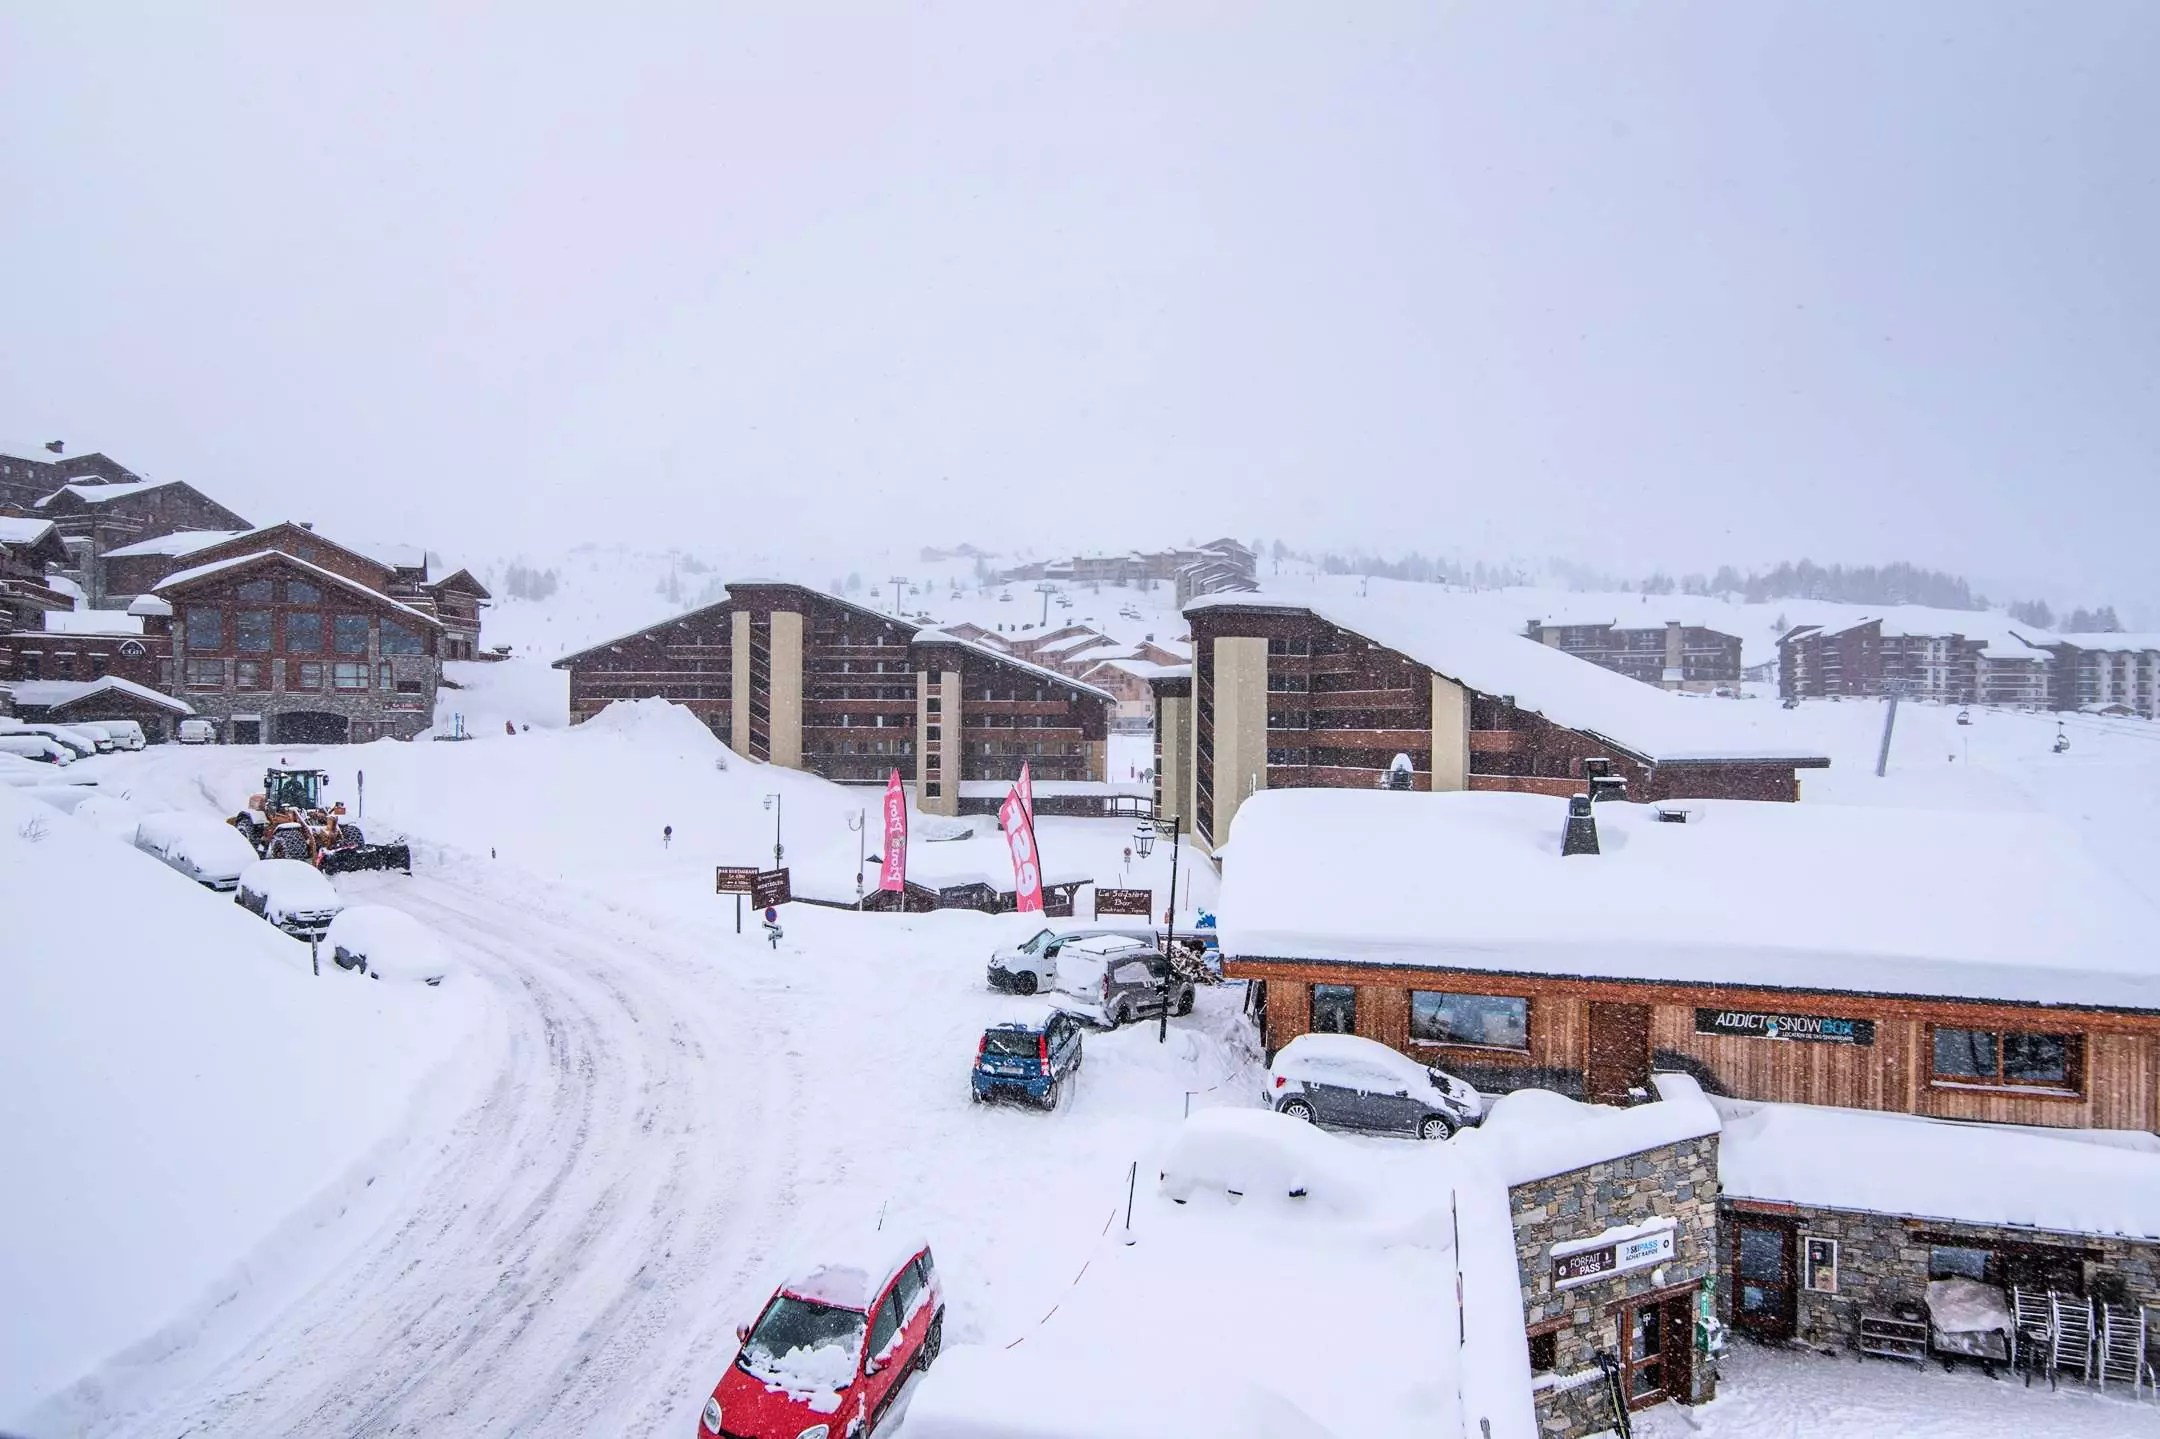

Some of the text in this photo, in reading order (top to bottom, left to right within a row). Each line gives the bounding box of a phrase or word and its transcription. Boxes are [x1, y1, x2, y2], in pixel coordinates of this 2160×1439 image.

[1715, 1012, 1767, 1029] ADDICT
[1570, 1252, 1601, 1269] FORFAIT
[1579, 1262, 1601, 1276] PASS
